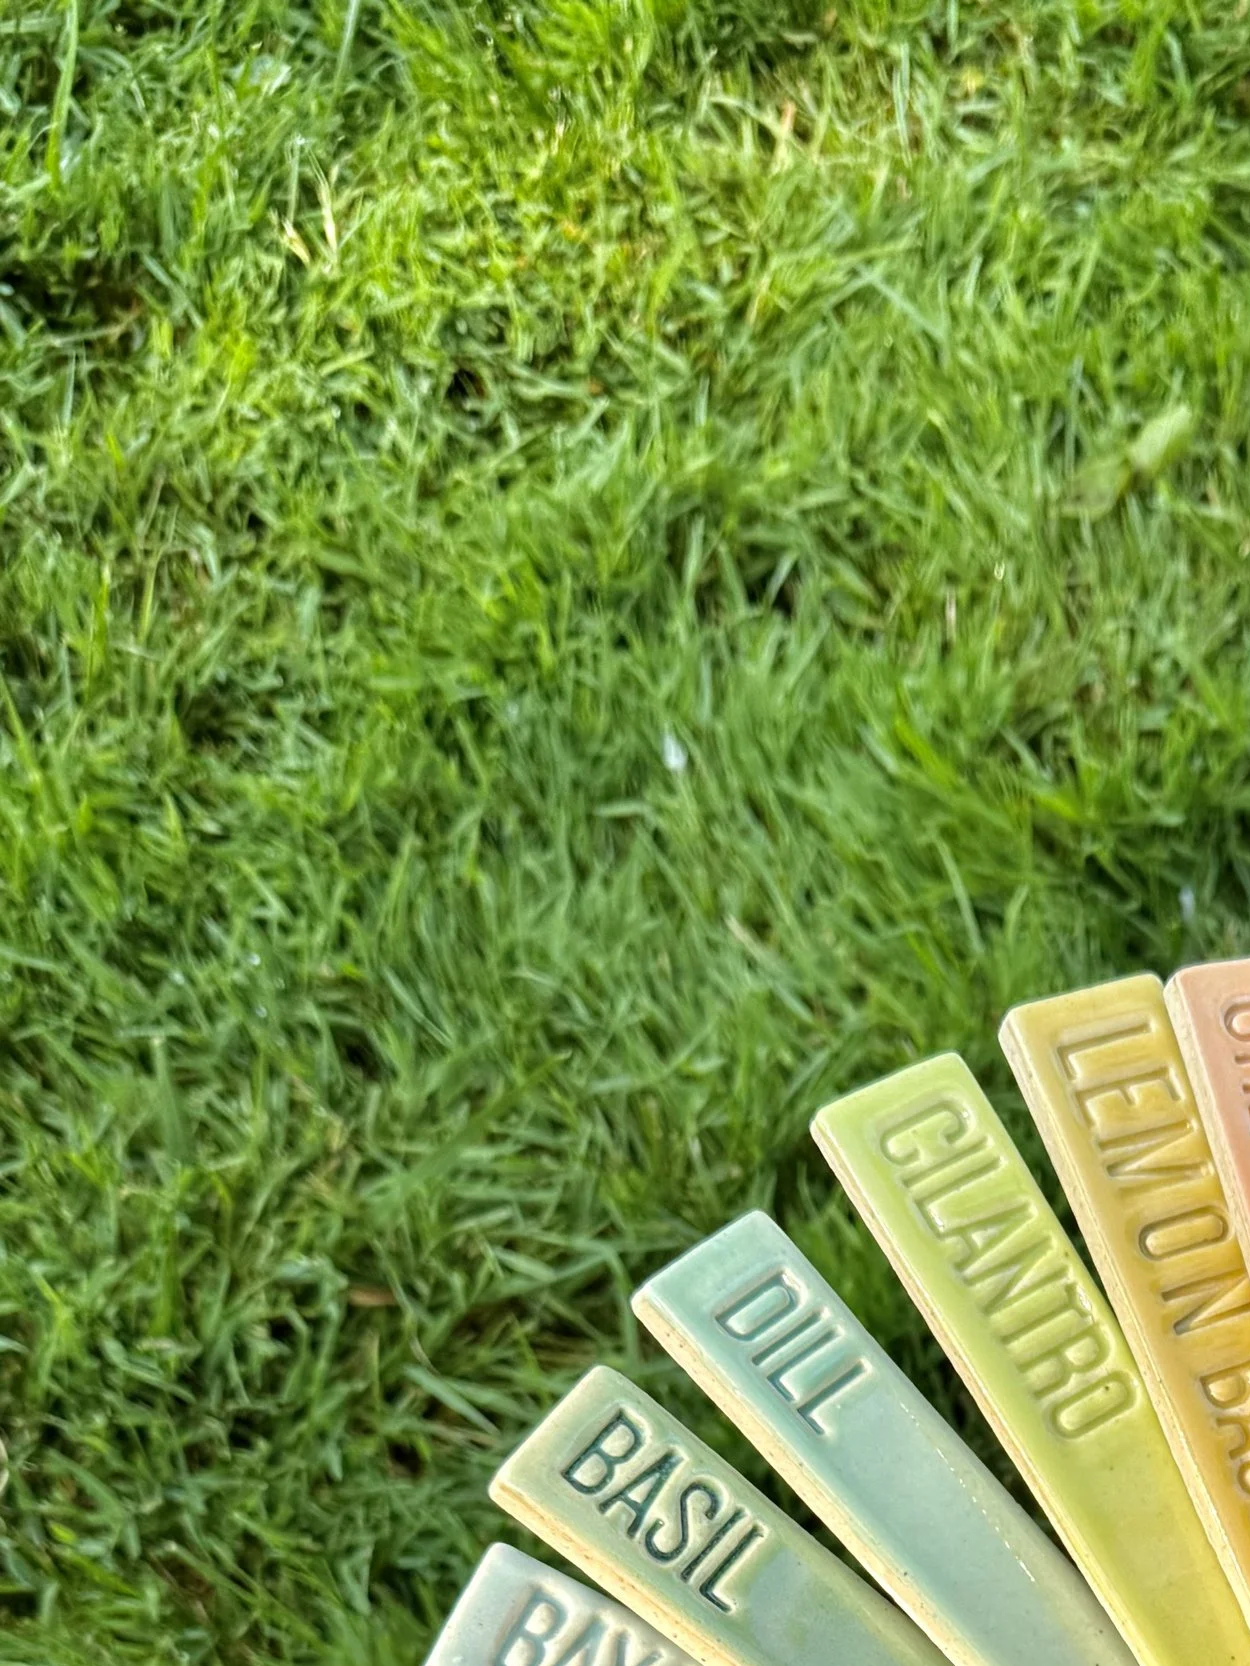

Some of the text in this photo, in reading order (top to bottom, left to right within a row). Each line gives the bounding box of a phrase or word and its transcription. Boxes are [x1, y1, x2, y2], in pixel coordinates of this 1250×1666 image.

[715, 1269, 868, 1435] DILL
[878, 1099, 1138, 1440] CILANTRO
[560, 1408, 766, 1615] BASIL
